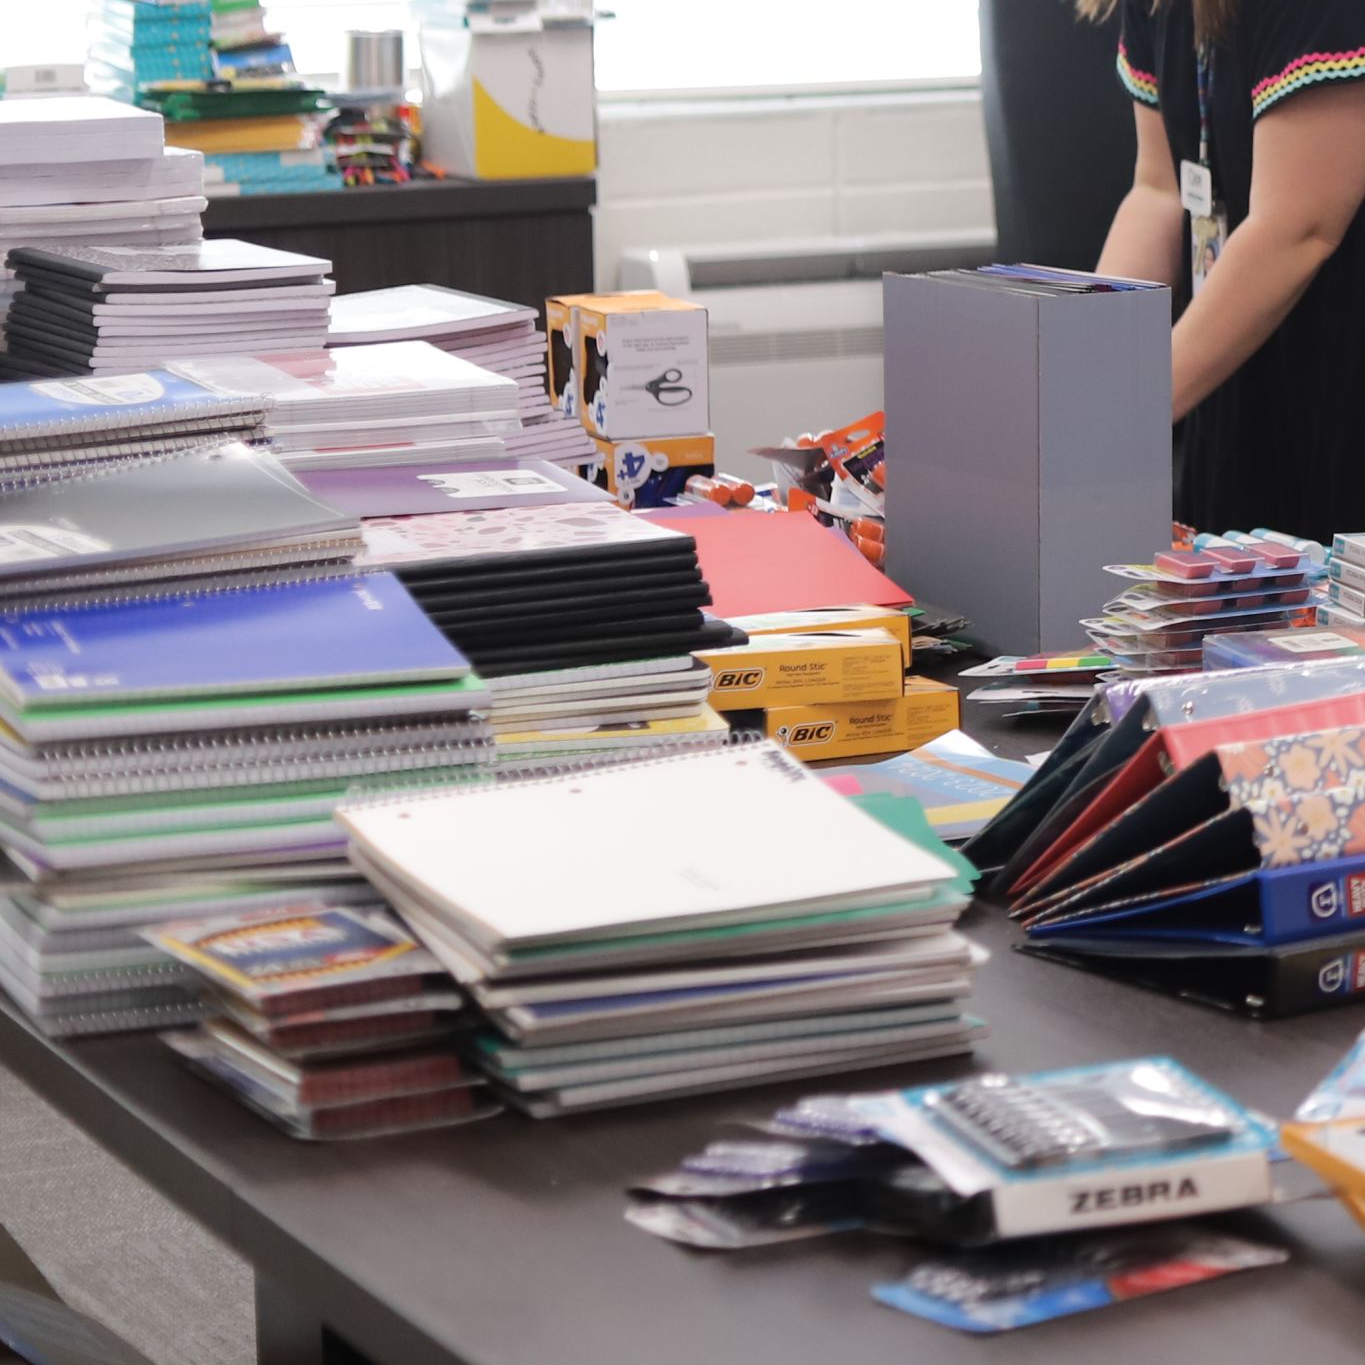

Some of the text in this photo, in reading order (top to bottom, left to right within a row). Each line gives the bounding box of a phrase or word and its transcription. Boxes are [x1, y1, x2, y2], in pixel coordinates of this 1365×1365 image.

[779, 663, 807, 672] Round
[717, 672, 761, 687] BIC
[849, 715, 875, 725] Round
[792, 726, 830, 742] BIC
[1352, 879, 1363, 913] HEAVY
[1070, 1178, 1200, 1215] ZEBRA
